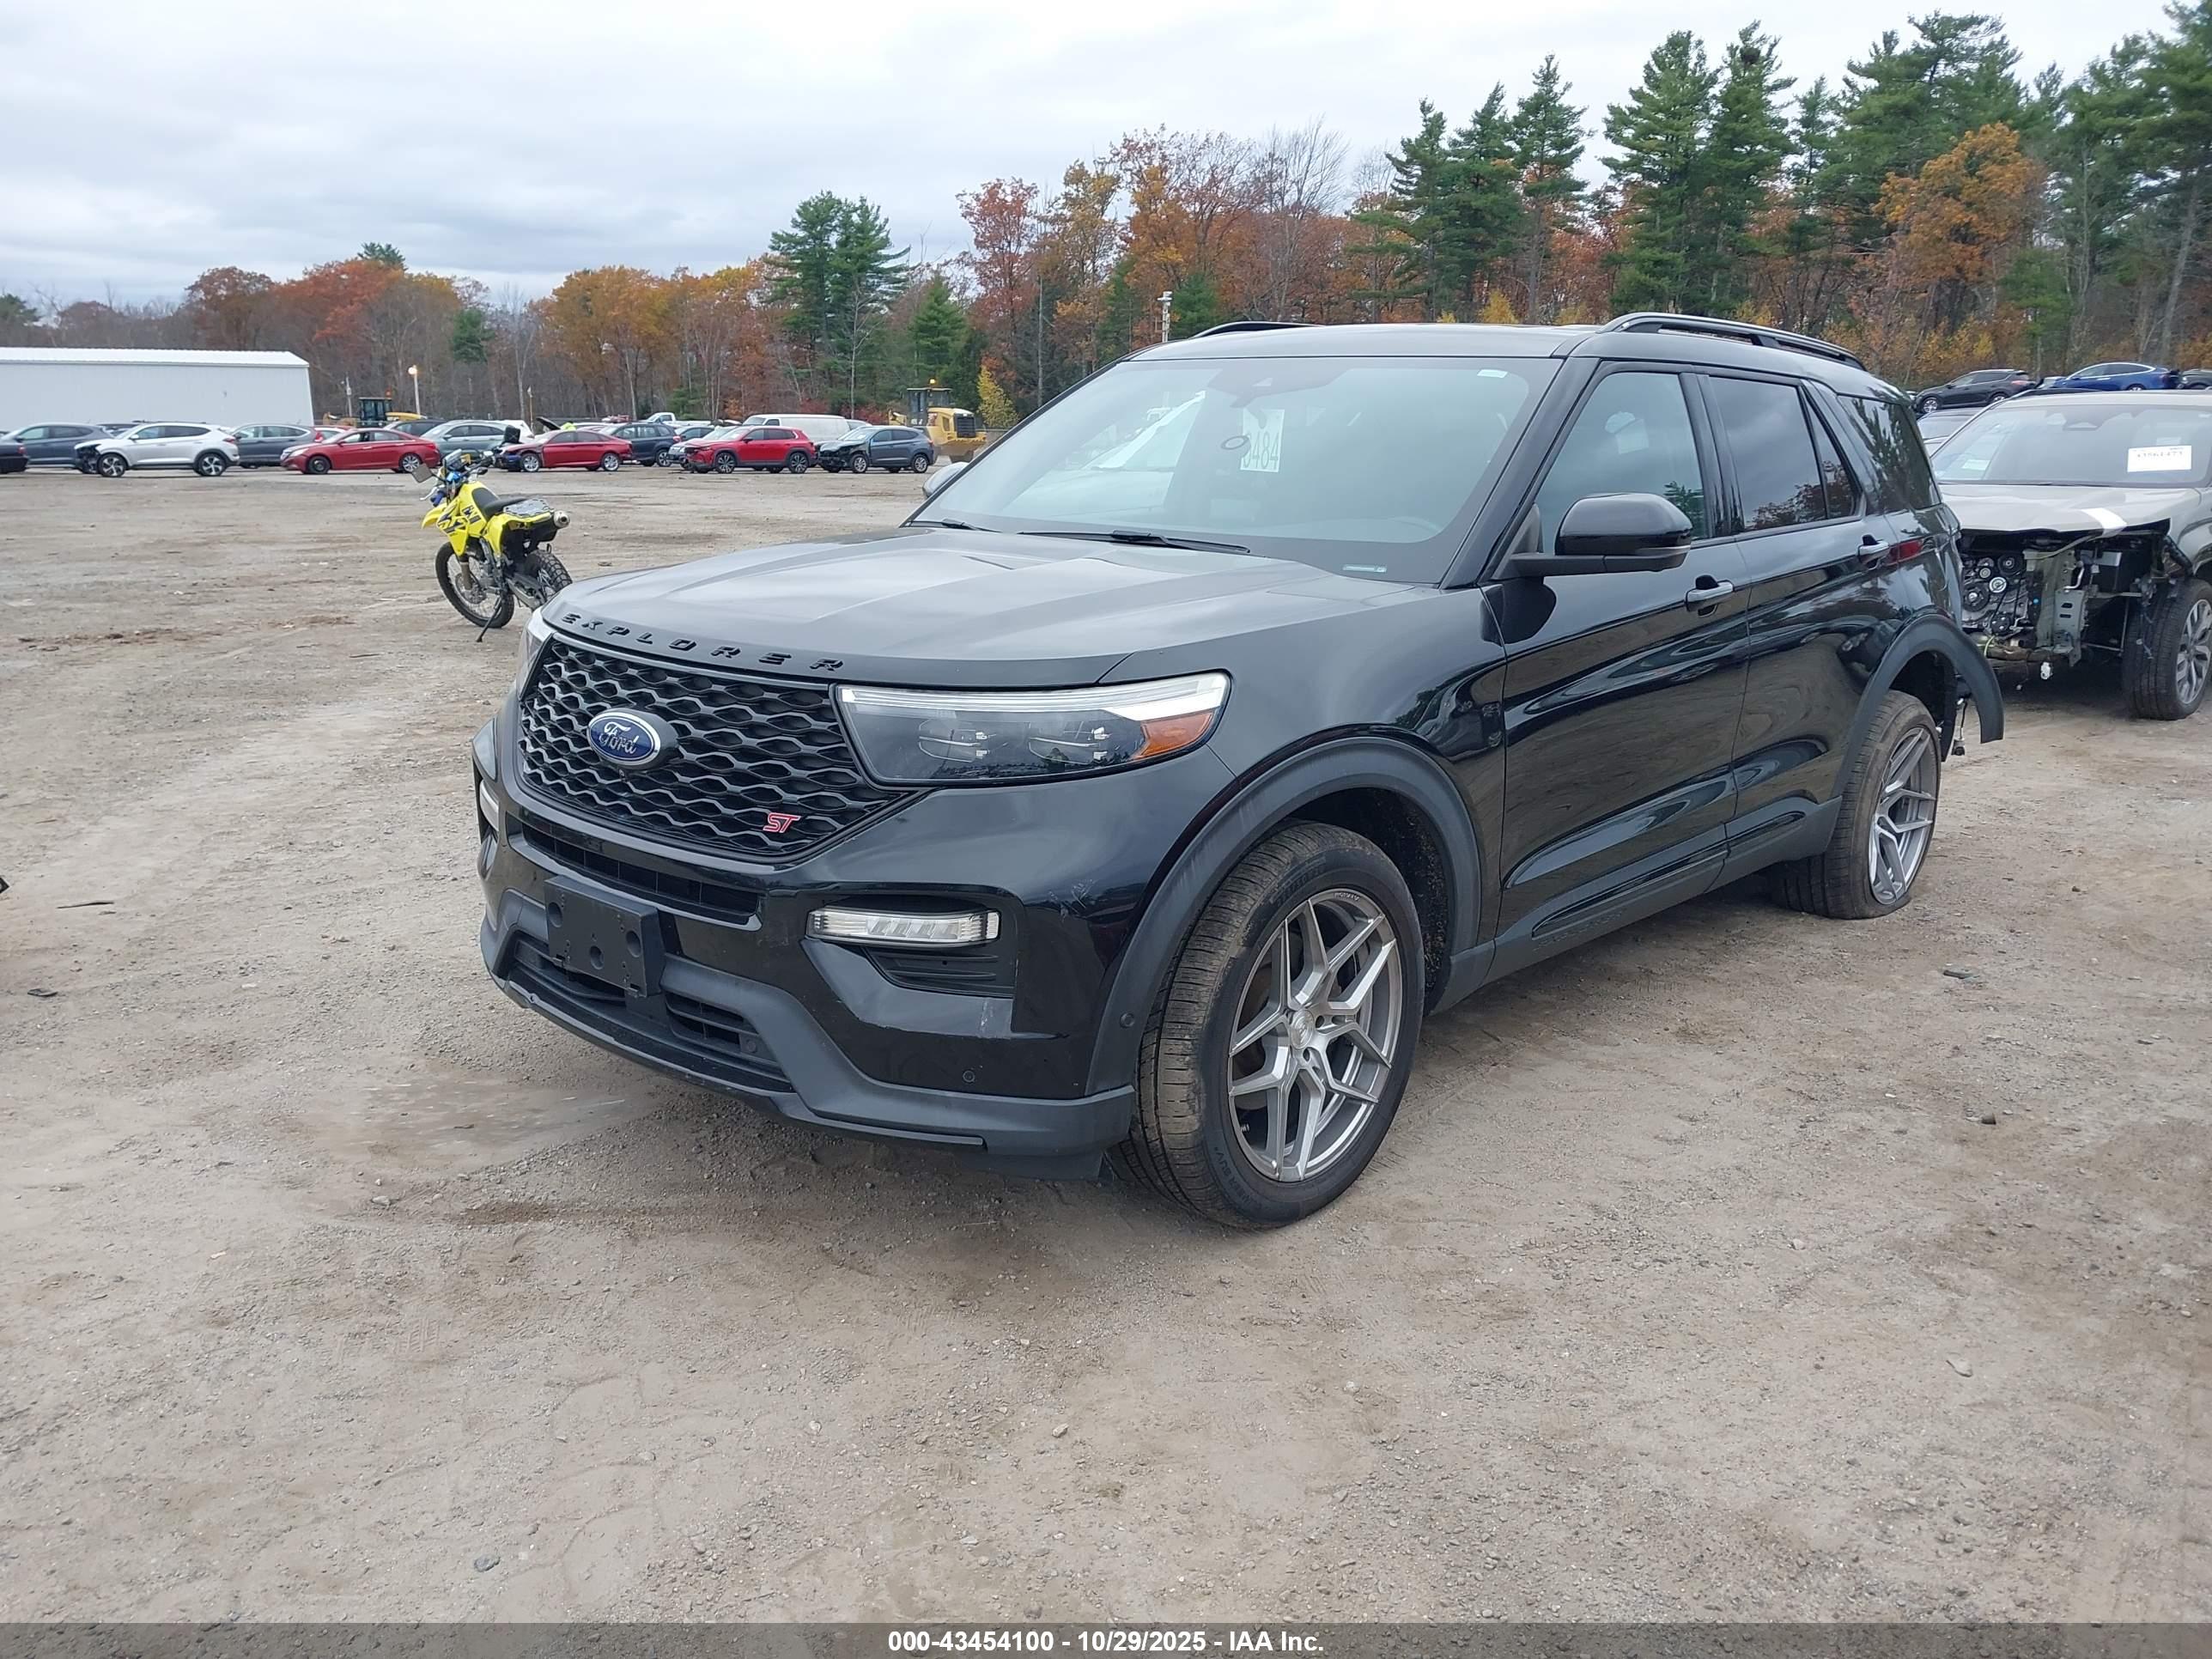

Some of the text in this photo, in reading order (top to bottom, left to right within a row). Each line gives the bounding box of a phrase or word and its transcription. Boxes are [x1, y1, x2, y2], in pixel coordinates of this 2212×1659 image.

[562, 611, 844, 672] EXPLORER
[599, 721, 640, 754] Ford
[762, 812, 802, 833] ST
